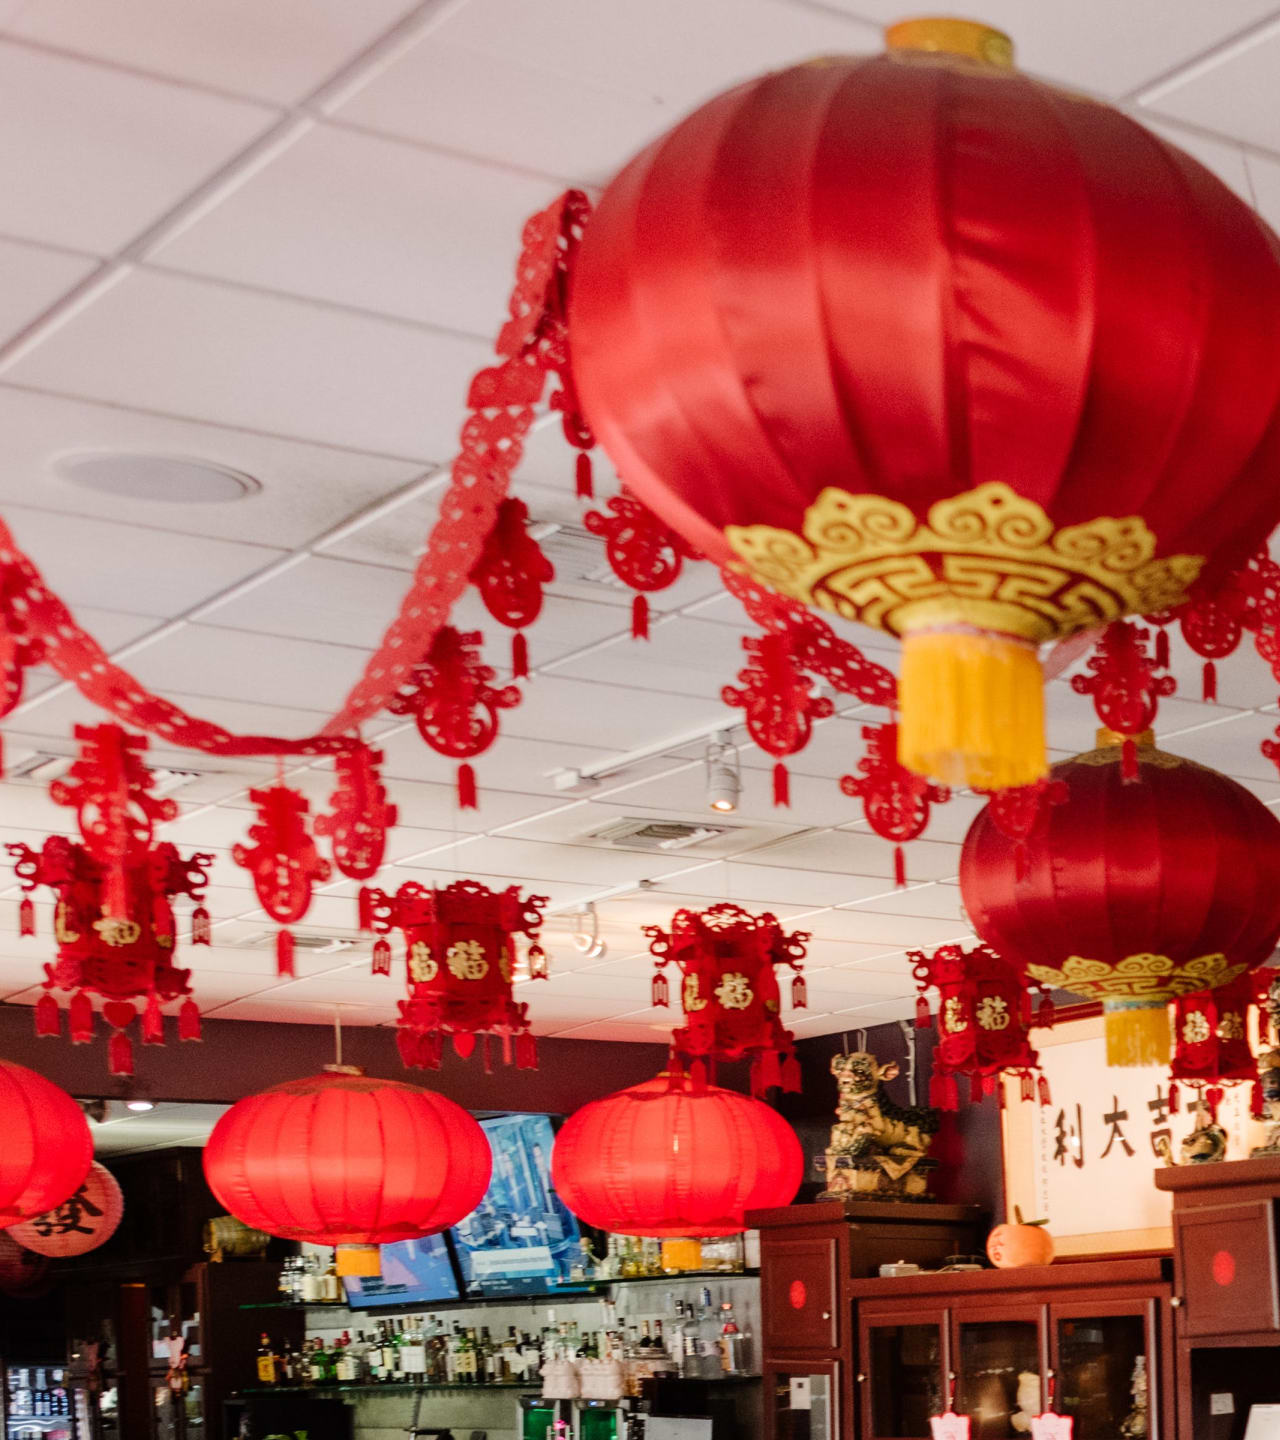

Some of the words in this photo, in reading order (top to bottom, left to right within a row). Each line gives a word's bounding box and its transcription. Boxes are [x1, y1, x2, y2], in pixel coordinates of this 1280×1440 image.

[446, 940, 489, 979] 福
[714, 972, 754, 1009] 福
[976, 996, 1010, 1030] 福
